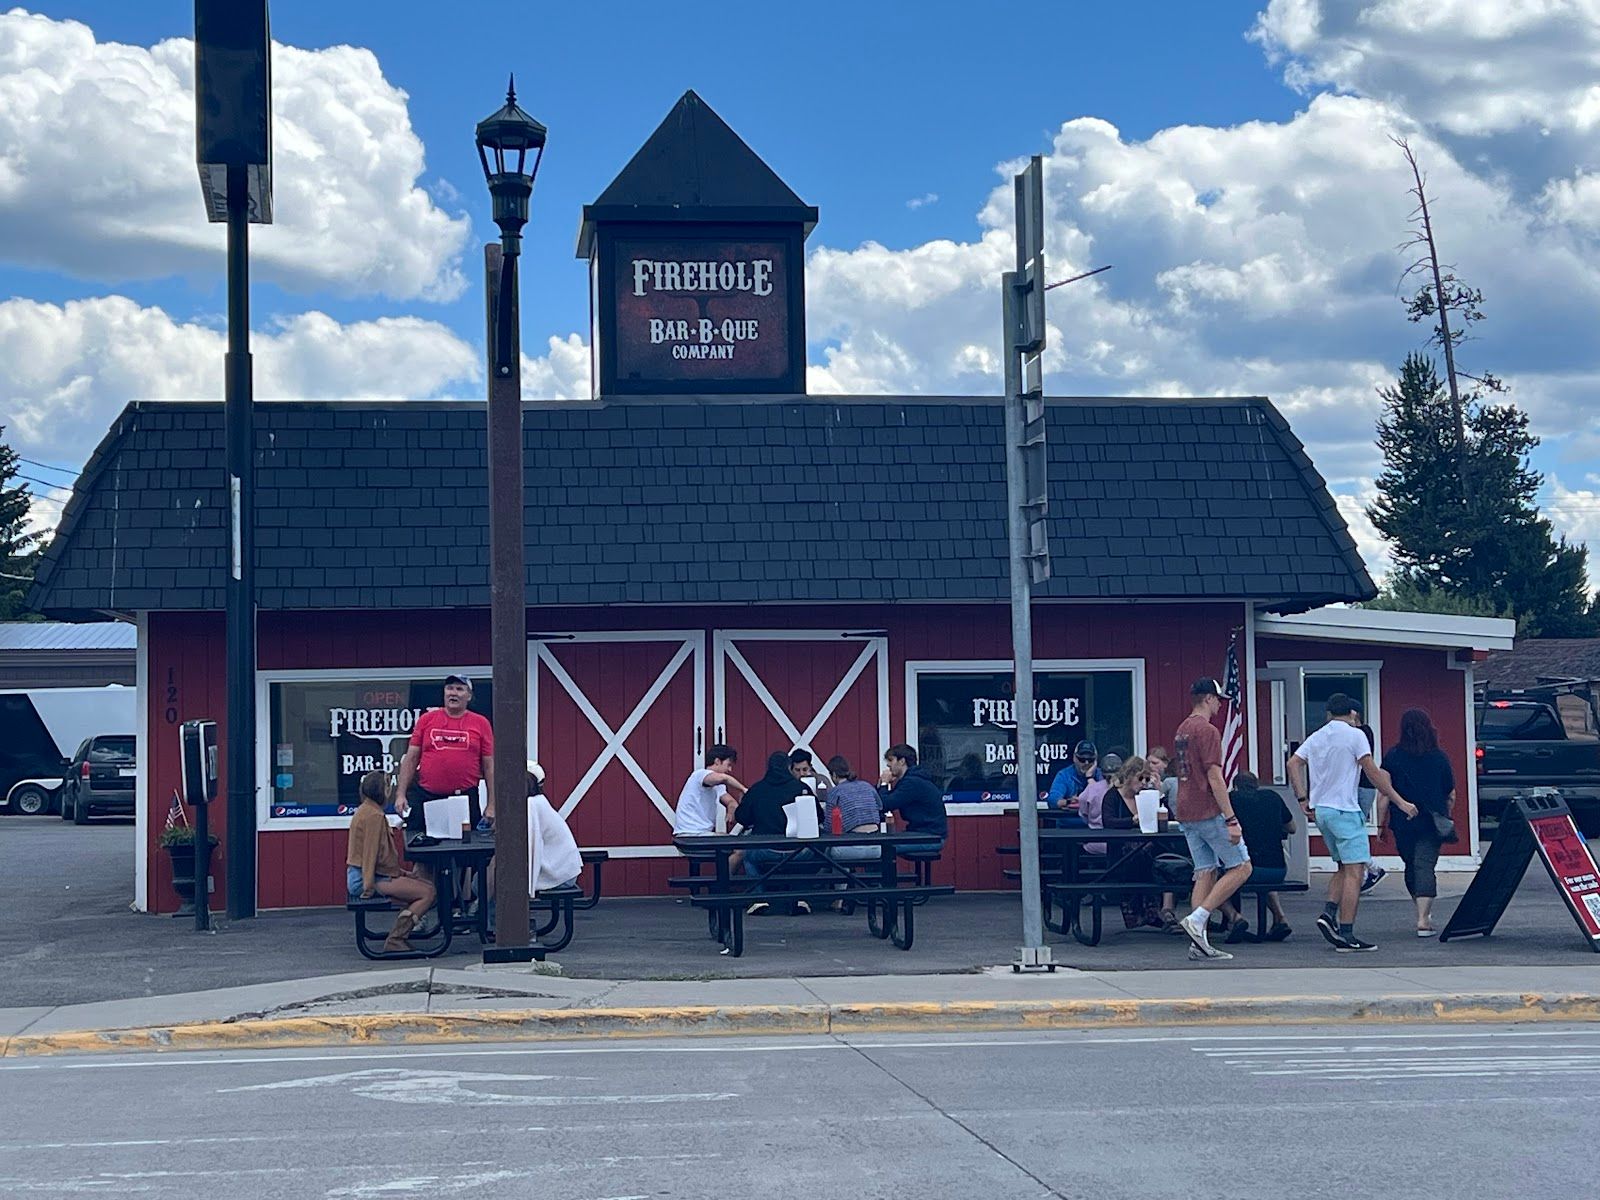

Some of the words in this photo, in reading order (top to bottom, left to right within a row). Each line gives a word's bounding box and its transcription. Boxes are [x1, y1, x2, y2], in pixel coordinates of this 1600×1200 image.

[632, 259, 773, 297] FIREHOLE
[672, 345, 735, 360] COMPANY
[363, 691, 405, 706] OPEN
[972, 698, 1079, 727] FIROLE
[991, 792, 1011, 800] pepsi
[286, 808, 308, 816] pepsi
